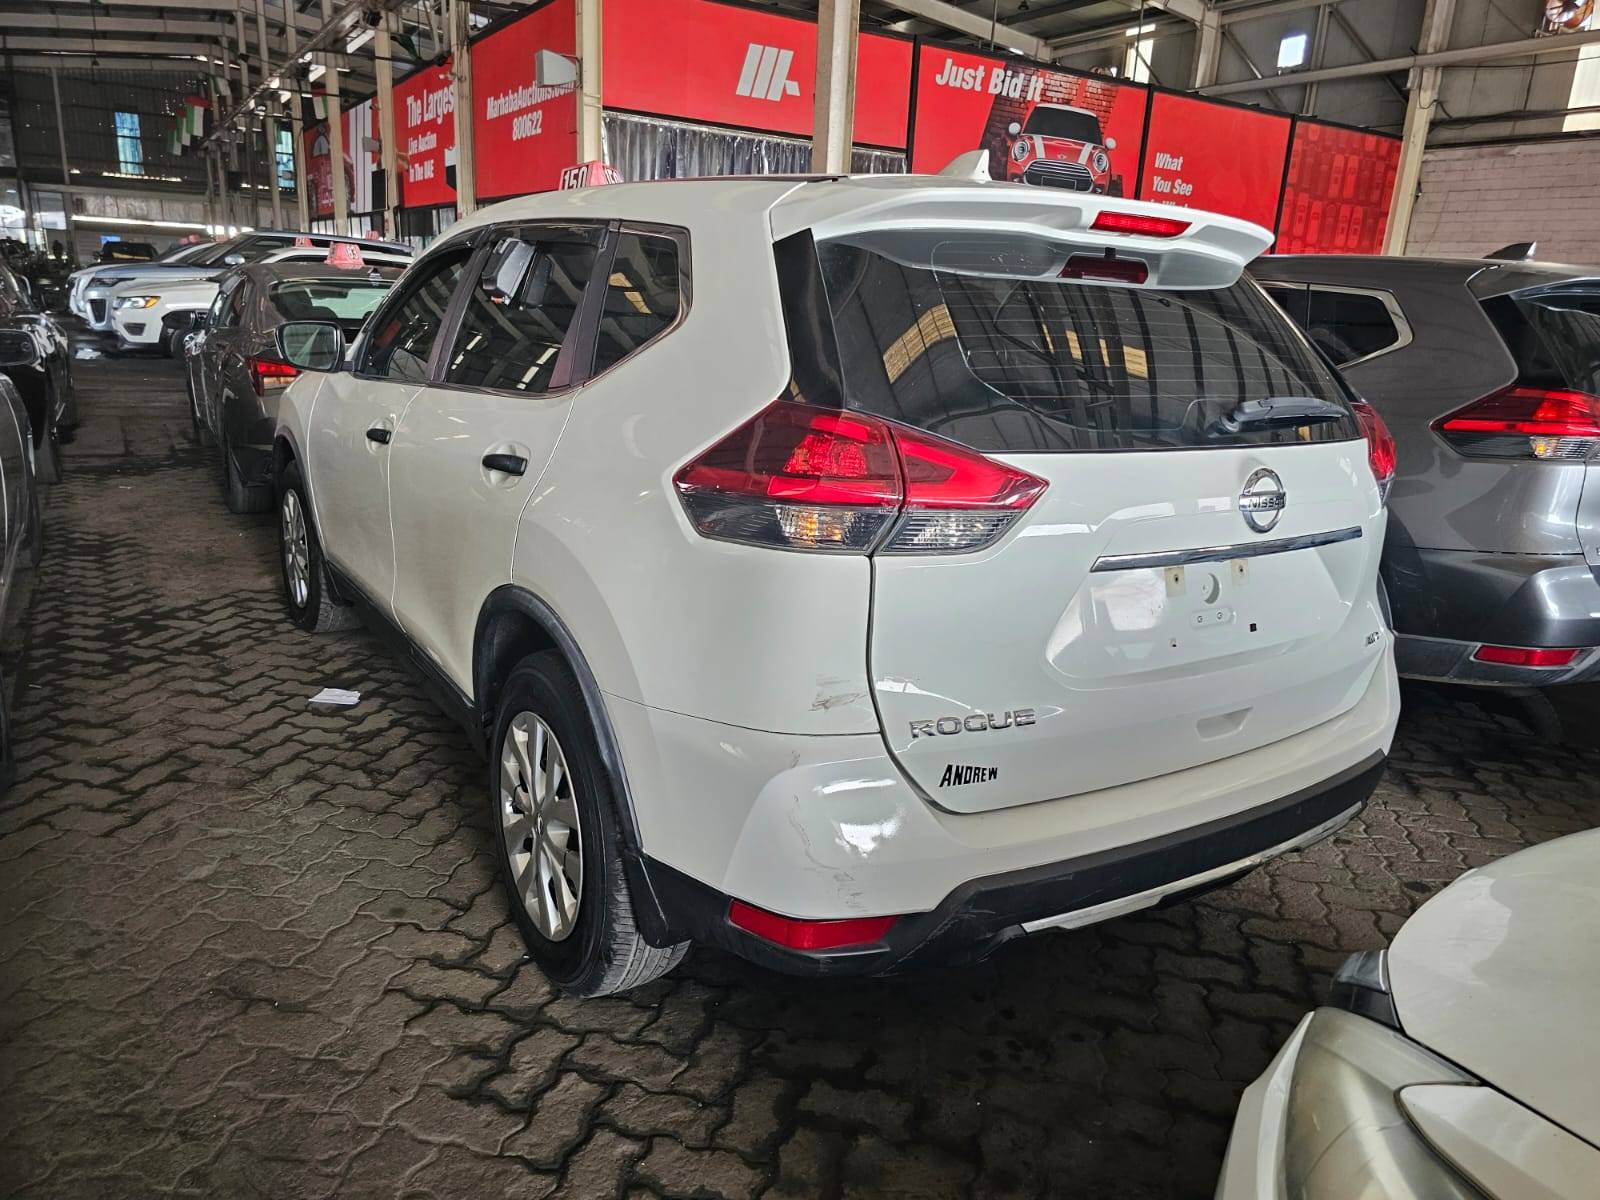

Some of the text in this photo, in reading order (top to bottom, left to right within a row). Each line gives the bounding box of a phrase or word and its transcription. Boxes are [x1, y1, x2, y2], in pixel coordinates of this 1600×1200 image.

[935, 58, 1044, 103] Just Bid It
[407, 85, 455, 128] The Larges
[512, 110, 543, 141] 800622
[1154, 152, 1183, 171] What
[563, 166, 588, 191] 150
[1152, 175, 1193, 196] You See
[909, 708, 1037, 739] ROGUE
[939, 764, 998, 788] ANDREW
